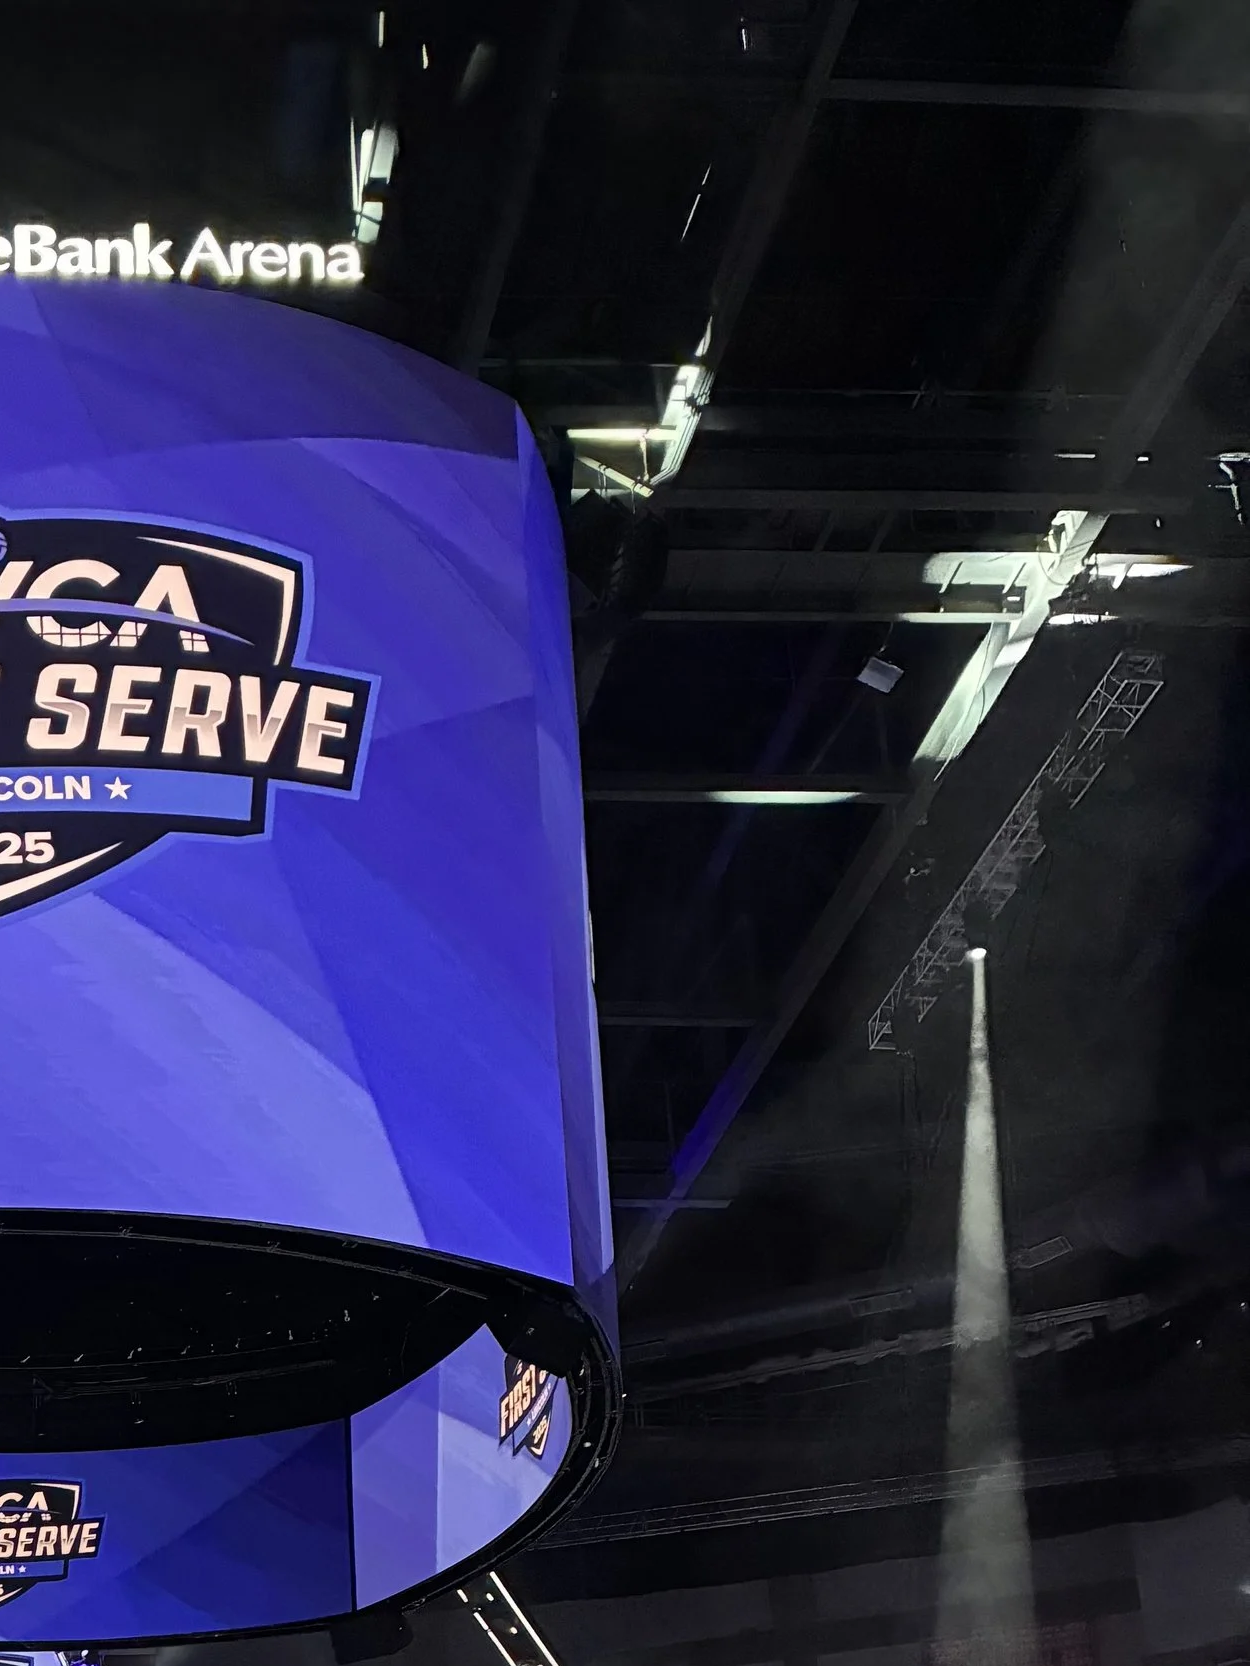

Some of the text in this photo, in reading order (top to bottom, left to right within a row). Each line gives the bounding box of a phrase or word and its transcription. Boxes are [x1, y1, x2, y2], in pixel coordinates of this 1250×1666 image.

[180, 226, 363, 283] Arena
[26, 664, 355, 775] SERVE
[500, 1364, 536, 1438] FIRST
